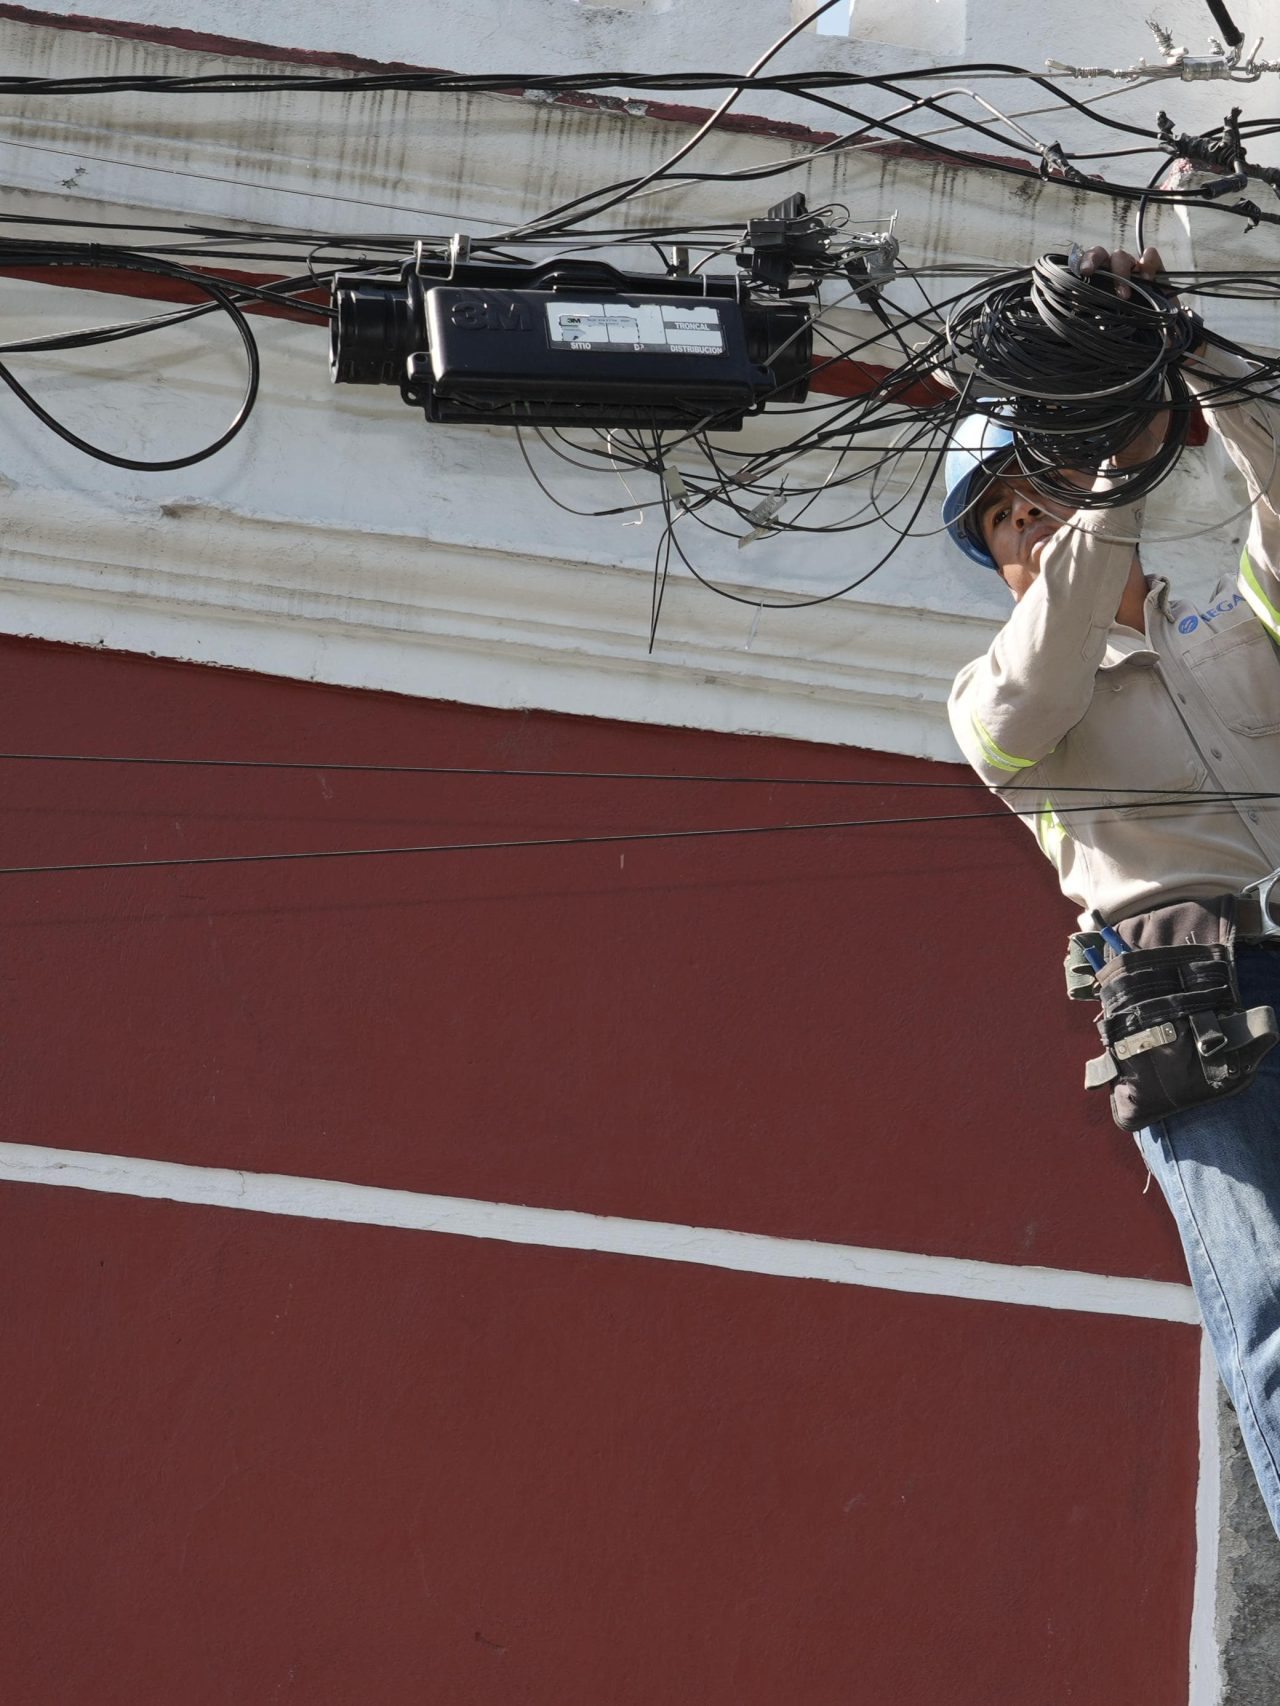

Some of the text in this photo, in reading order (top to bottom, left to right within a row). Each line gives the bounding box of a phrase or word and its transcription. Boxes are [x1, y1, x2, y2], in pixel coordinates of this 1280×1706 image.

[451, 301, 533, 331] 3M
[675, 322, 711, 331] TRONCAL
[571, 342, 592, 350] SITIO
